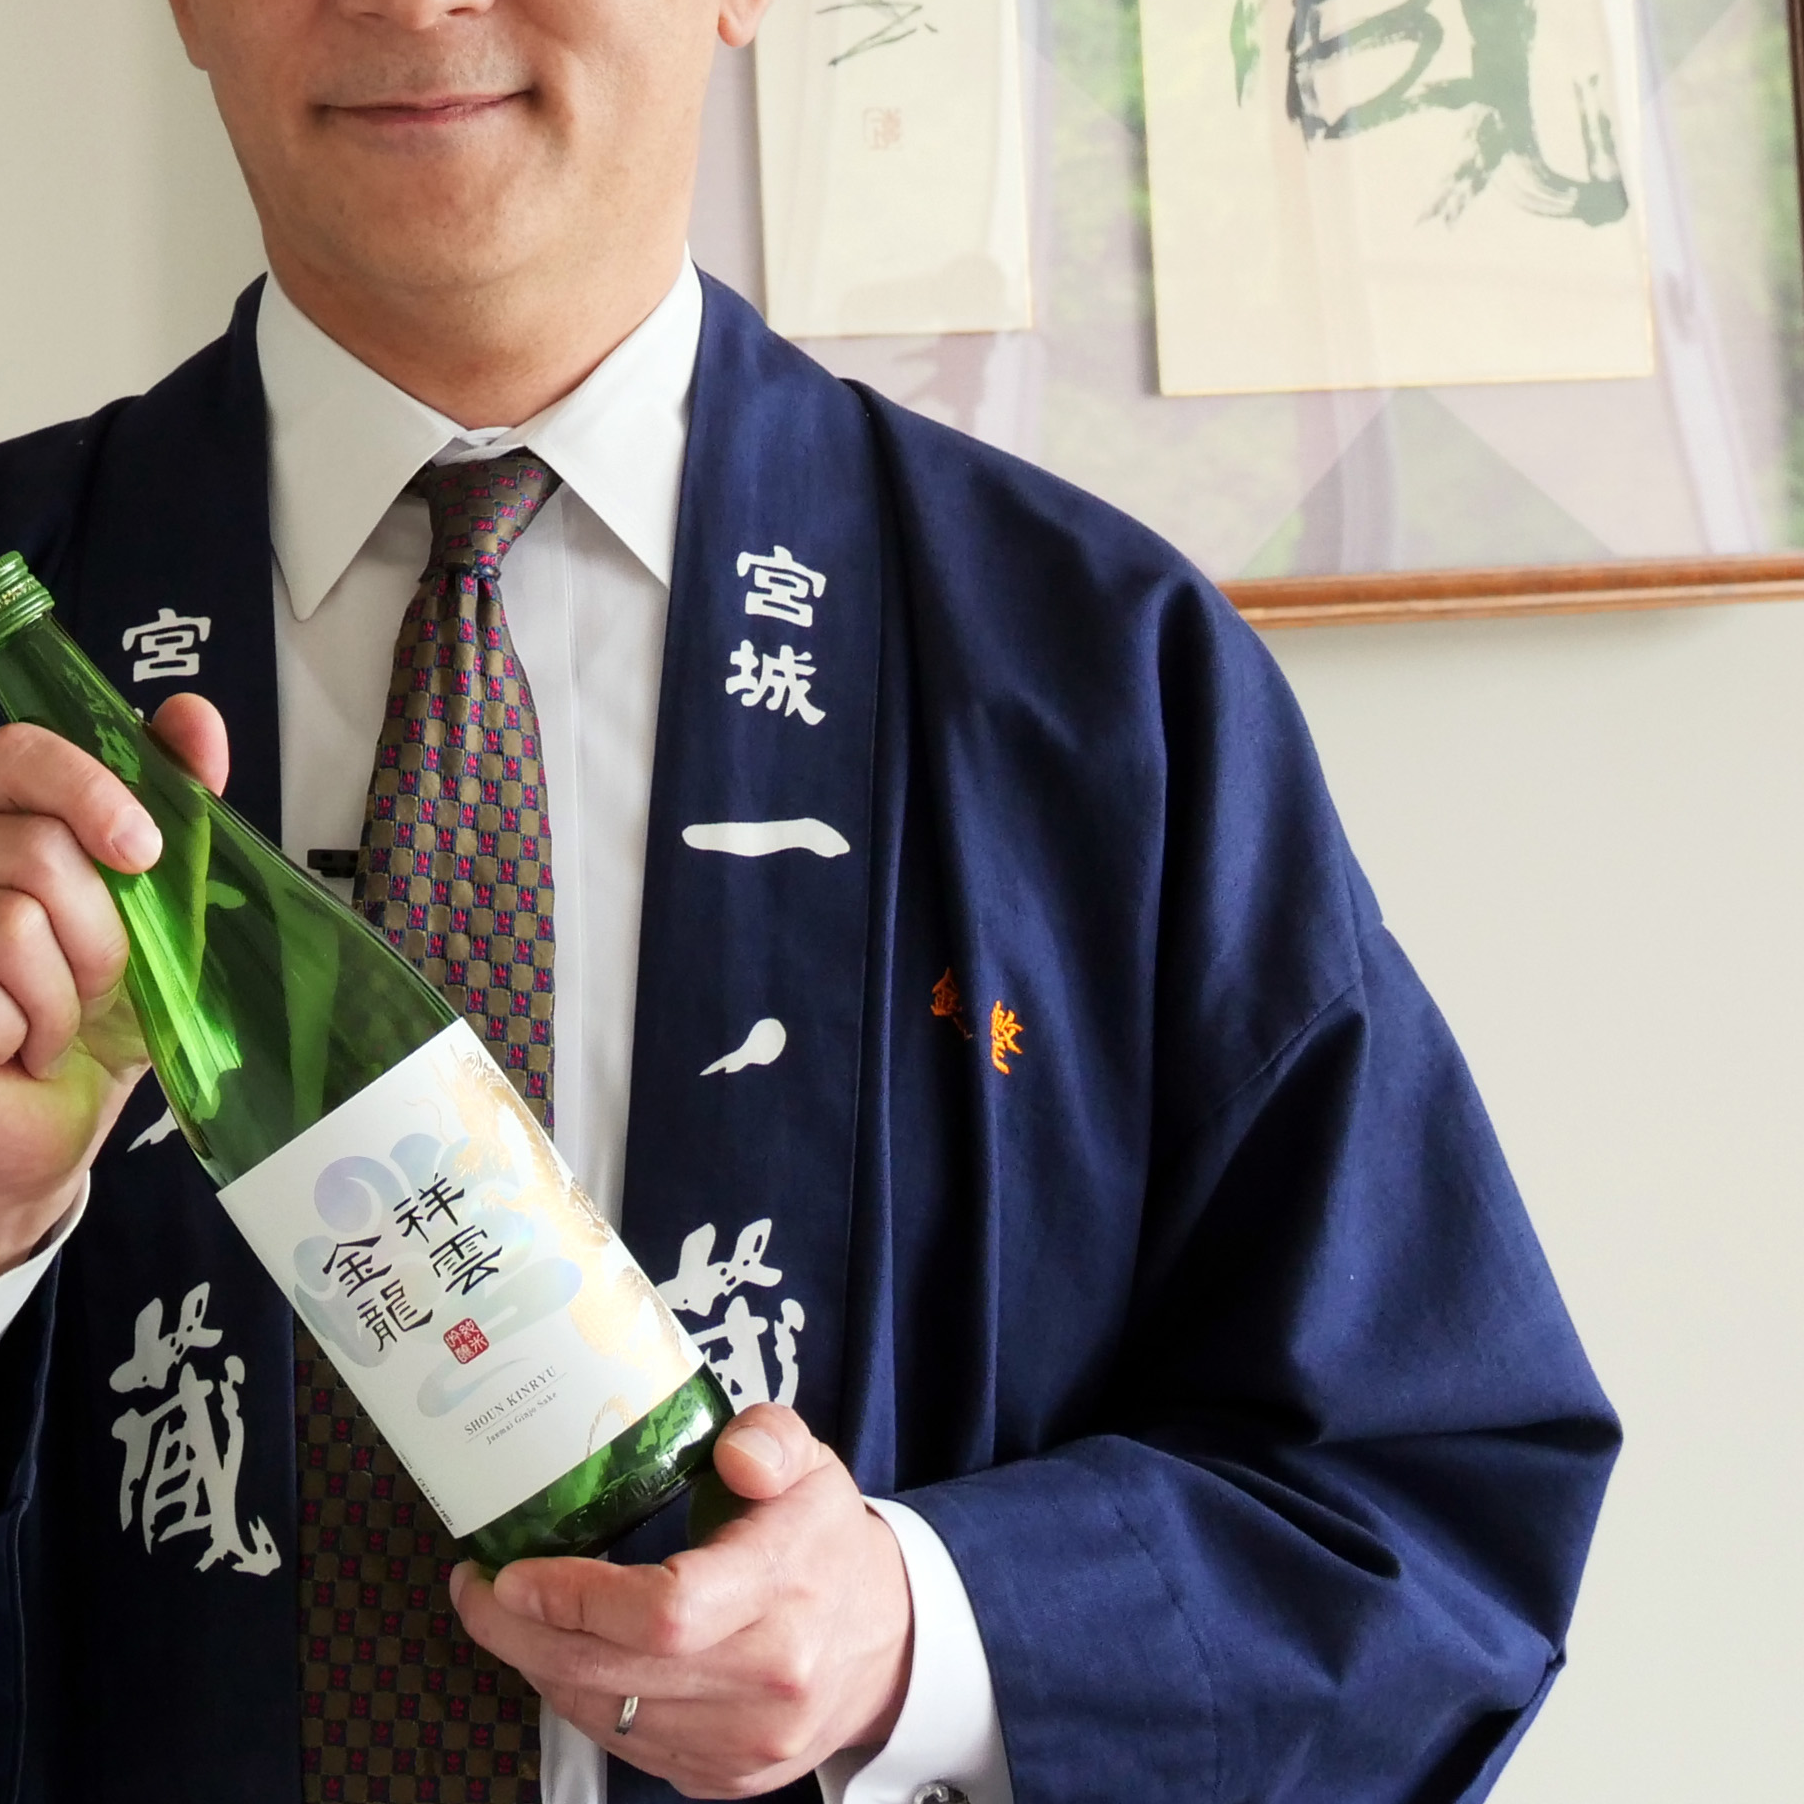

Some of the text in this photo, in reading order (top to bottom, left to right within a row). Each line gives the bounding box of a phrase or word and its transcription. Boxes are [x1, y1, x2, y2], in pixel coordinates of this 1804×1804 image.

[122, 607, 211, 718] 宮
[725, 544, 828, 725] 宮城
[393, 1172, 503, 1295] 祥雲
[322, 1234, 434, 1352] 金龍
[464, 1365, 557, 1436] SHOUN KINRYU
